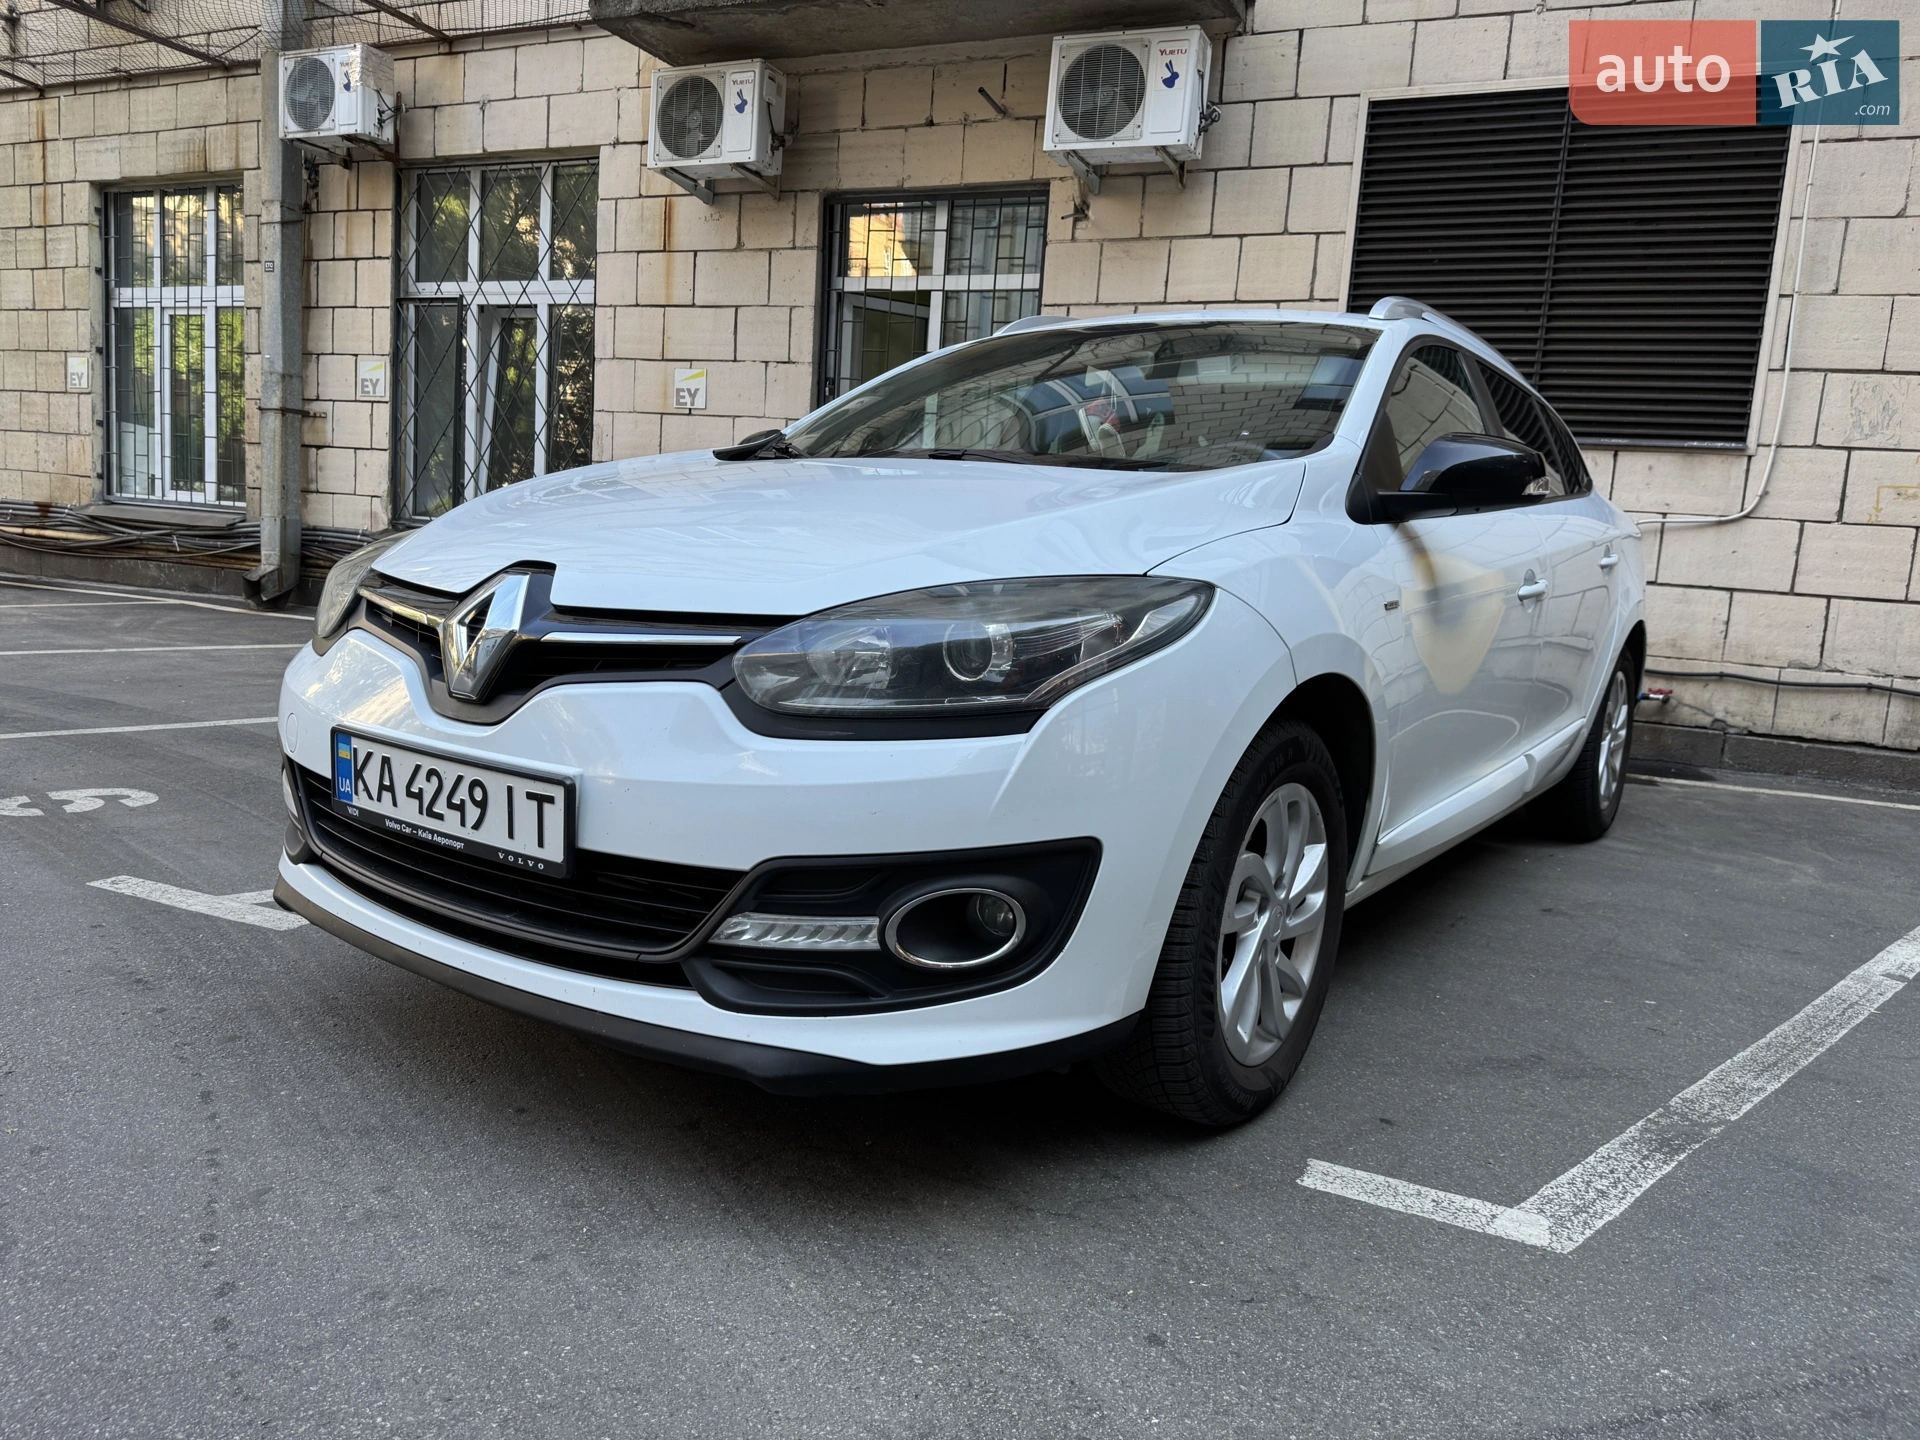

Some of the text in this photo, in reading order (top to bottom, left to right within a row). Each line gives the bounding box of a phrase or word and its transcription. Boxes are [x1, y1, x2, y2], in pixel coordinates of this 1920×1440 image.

[70, 371, 84, 387] EY
[360, 377, 380, 395] EY
[675, 387, 700, 407] EY
[338, 776, 352, 795] UA
[352, 745, 555, 848] KA 4249 IT
[384, 818, 401, 831] Volvo
[401, 823, 412, 835] Car
[418, 829, 432, 841] Київ
[497, 851, 544, 870] VOLVO
